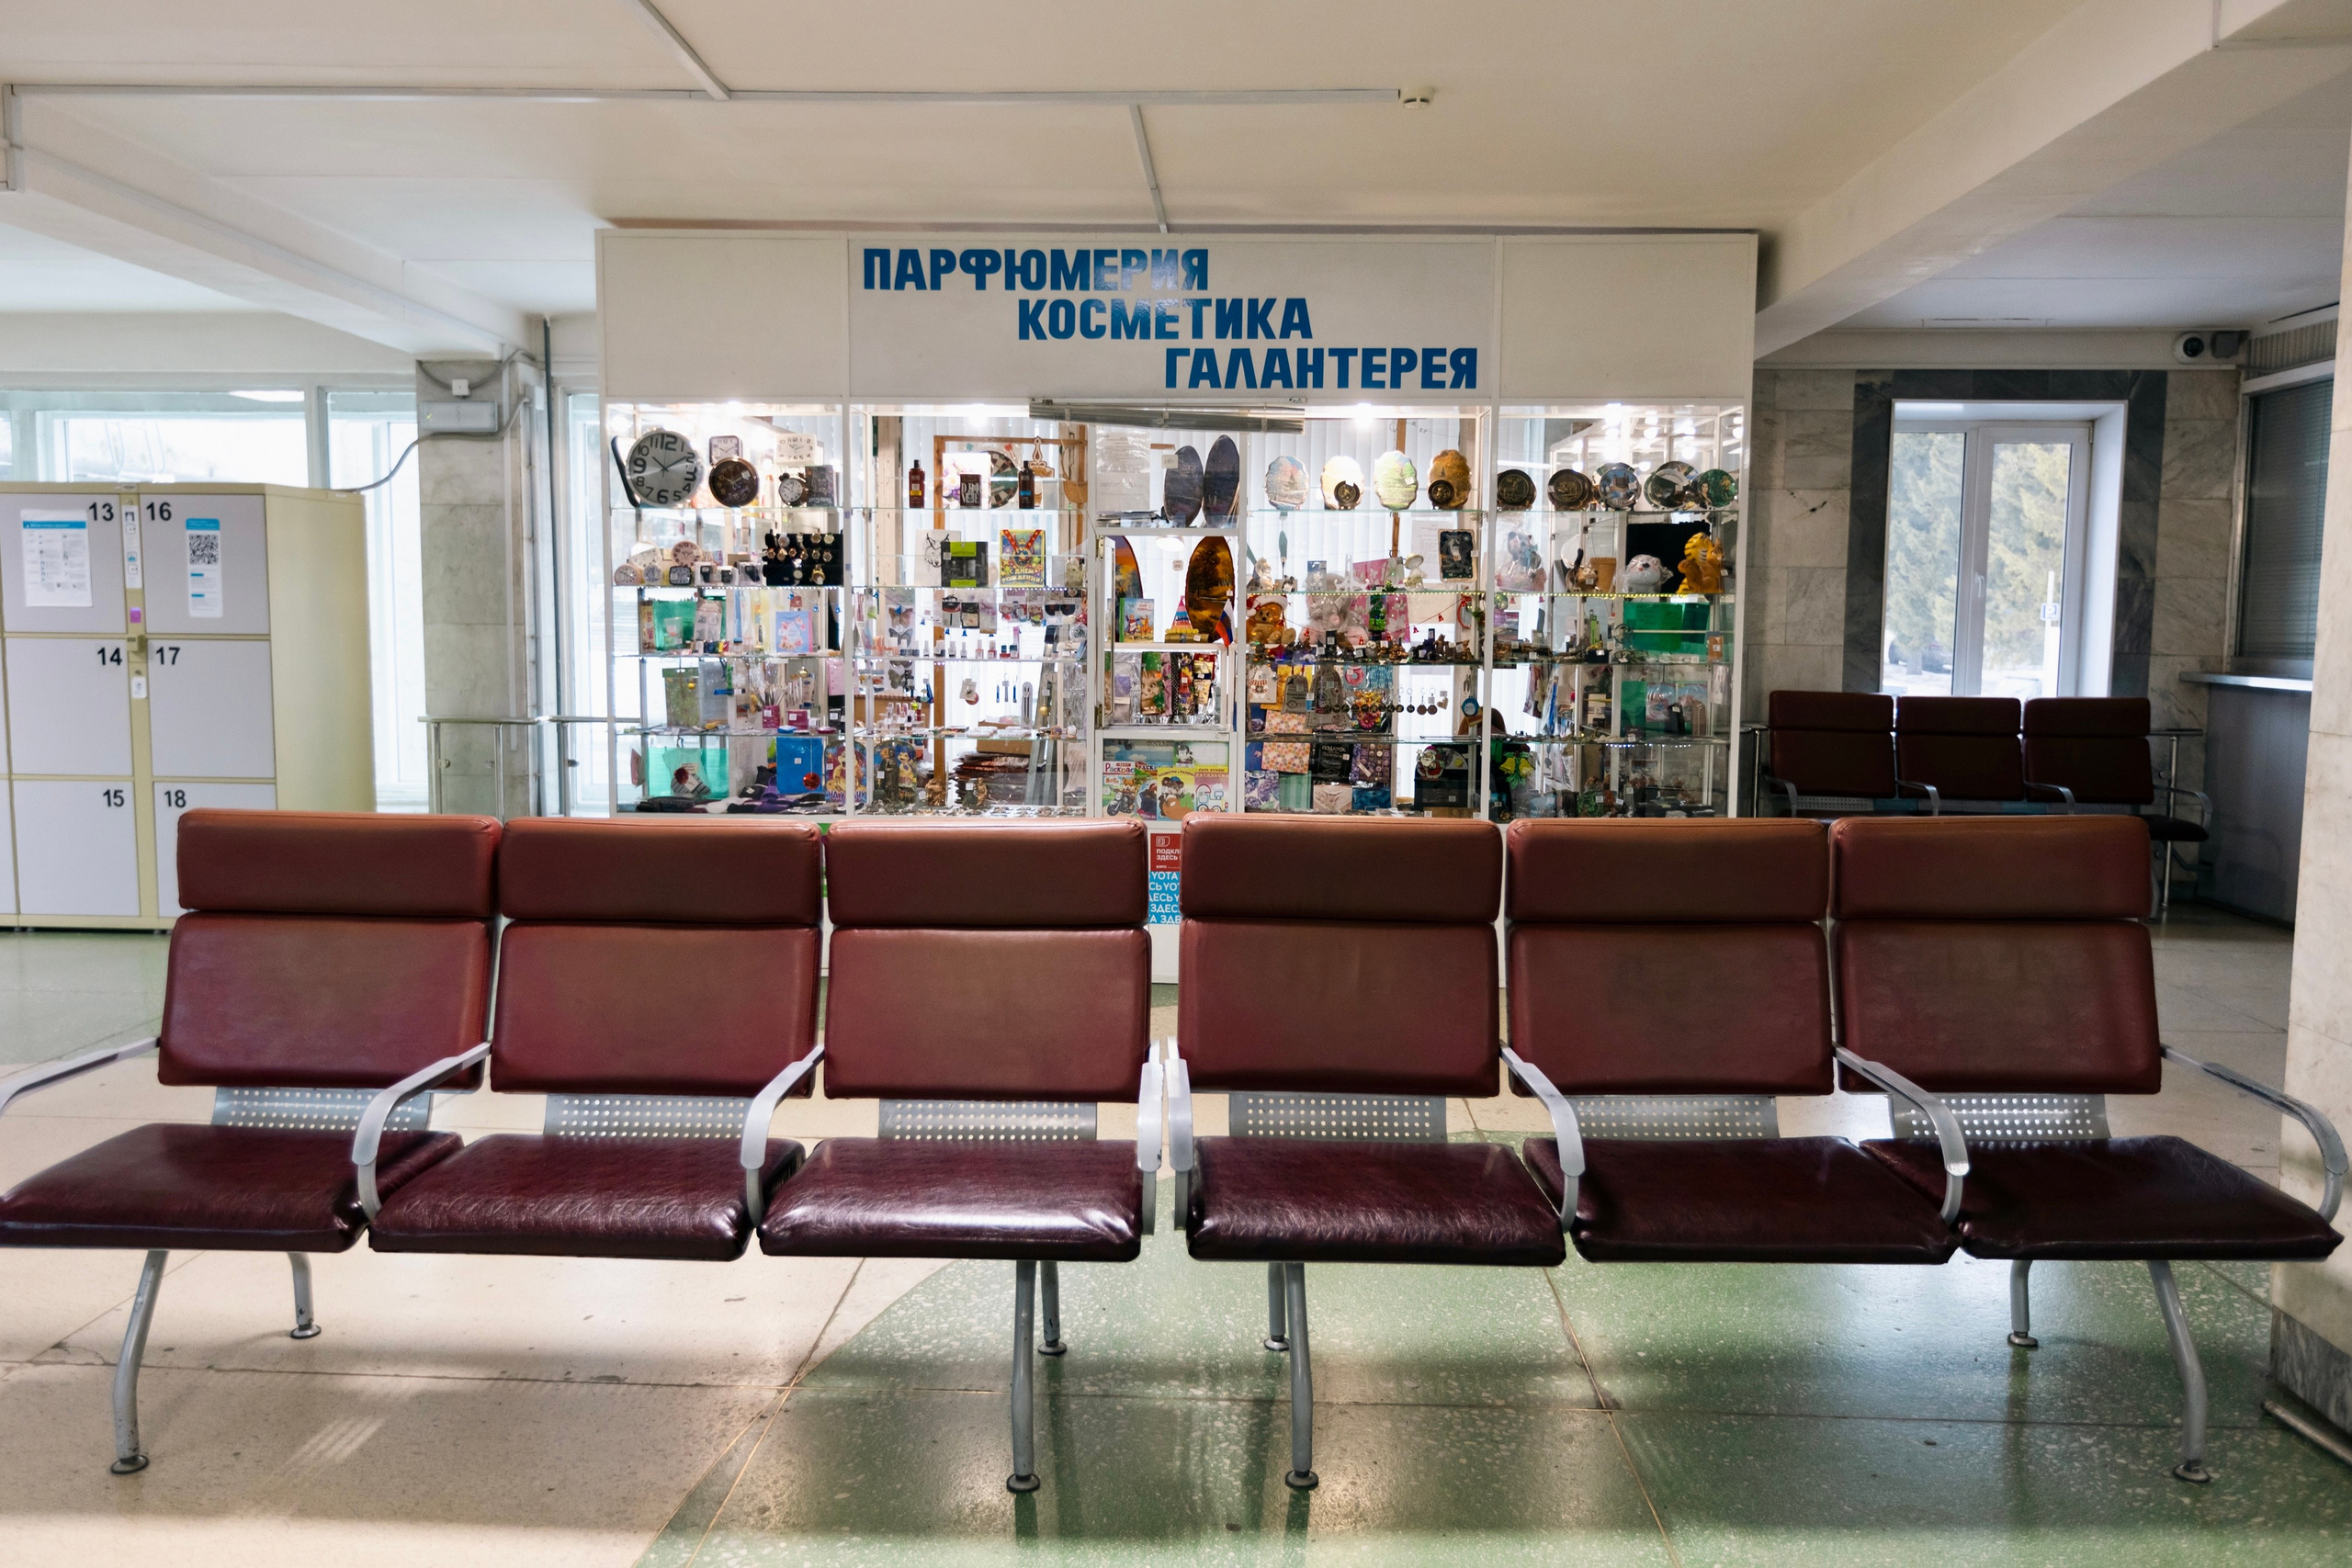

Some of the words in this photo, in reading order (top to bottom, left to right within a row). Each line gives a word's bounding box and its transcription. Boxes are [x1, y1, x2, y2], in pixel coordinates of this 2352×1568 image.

[864, 248, 1209, 291] ПАРФЮМЕРИЯ
[1018, 298, 1314, 341] КОСМЕТИКА
[1165, 347, 1478, 389] ГАЛАНТЕРЕЯ
[650, 437, 658, 448] 11
[660, 434, 678, 451] 12
[681, 442, 684, 452] 1
[638, 445, 650, 457] 10
[686, 452, 695, 463] 2
[633, 457, 647, 474] 9
[636, 476, 645, 487] 8
[683, 483, 692, 493] 4
[646, 487, 655, 499] 7
[657, 489, 669, 504] 6
[673, 491, 682, 502] 5
[88, 502, 115, 522] 13
[146, 502, 173, 522] 16
[97, 647, 123, 666] 14
[155, 646, 181, 665] 17
[103, 789, 125, 807] 15
[164, 789, 187, 808] 18
[1151, 871, 1178, 880] YOTA
[1150, 904, 1181, 914] ЗДЕС
